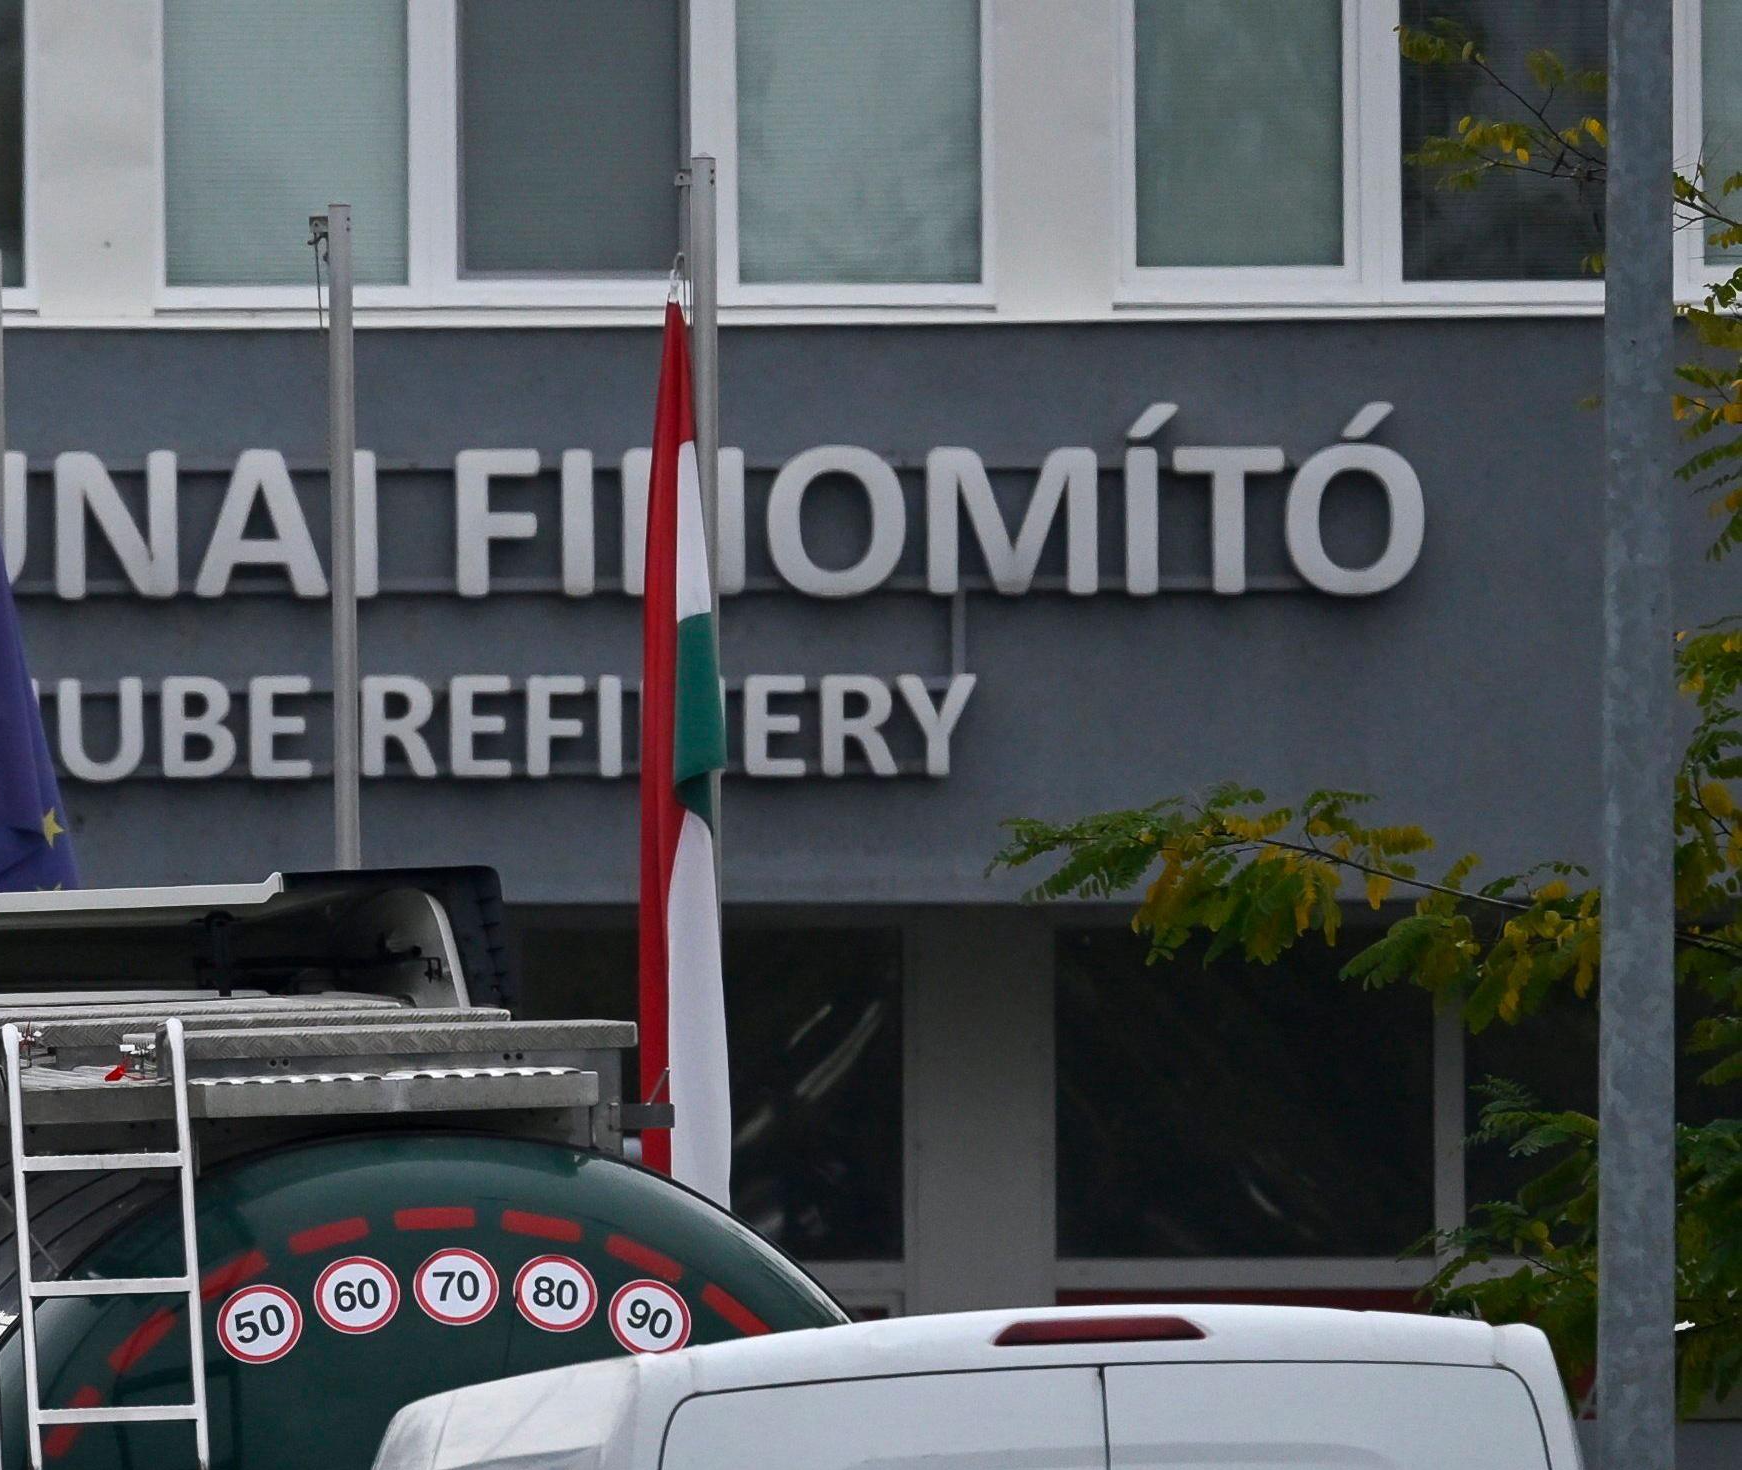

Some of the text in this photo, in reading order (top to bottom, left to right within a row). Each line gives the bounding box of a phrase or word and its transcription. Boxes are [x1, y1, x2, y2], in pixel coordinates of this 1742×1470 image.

[361, 672, 977, 778] REFIERY
[333, 1277, 380, 1312] 60
[432, 1270, 480, 1302] 70
[531, 1276, 579, 1310] 80
[233, 1304, 285, 1345] 50
[625, 1298, 673, 1339] 90
